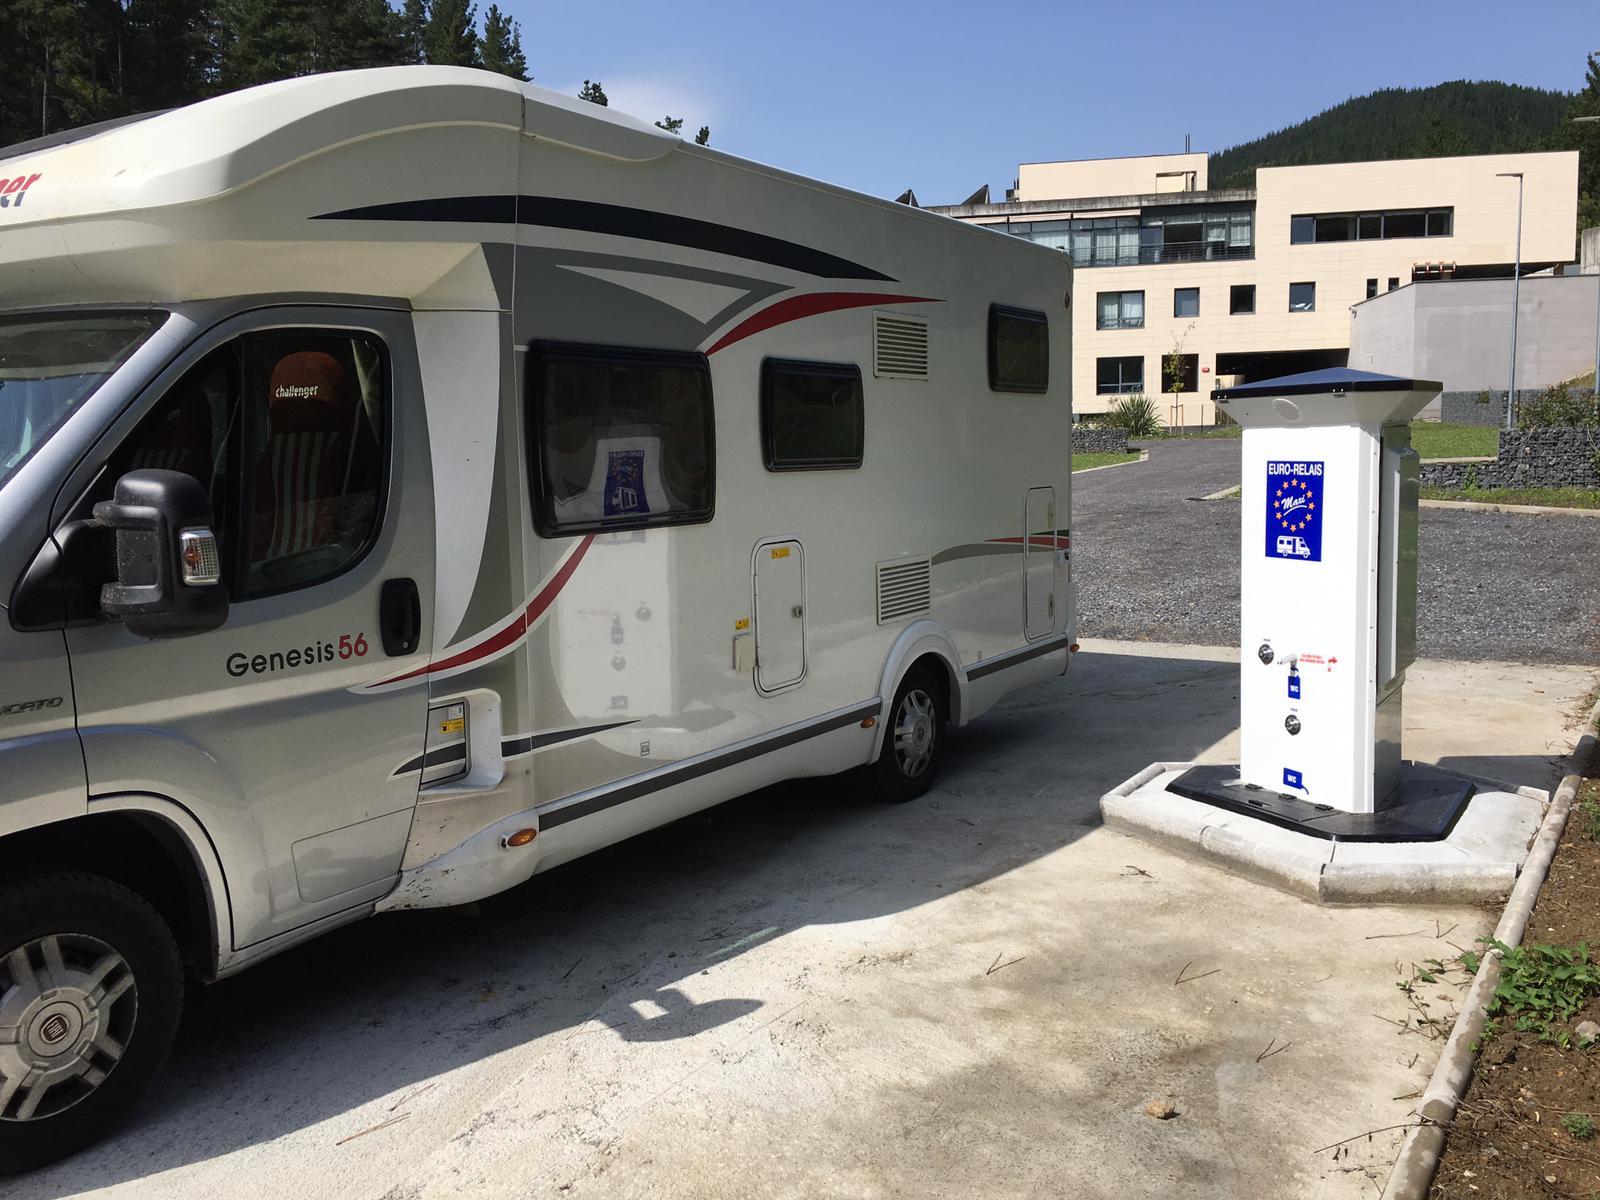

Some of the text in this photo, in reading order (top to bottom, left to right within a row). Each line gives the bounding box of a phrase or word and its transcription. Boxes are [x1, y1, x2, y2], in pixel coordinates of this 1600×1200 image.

[275, 384, 318, 399] challenger
[1268, 463, 1322, 476] EURO-RELAIS
[1281, 495, 1306, 510] Maxi
